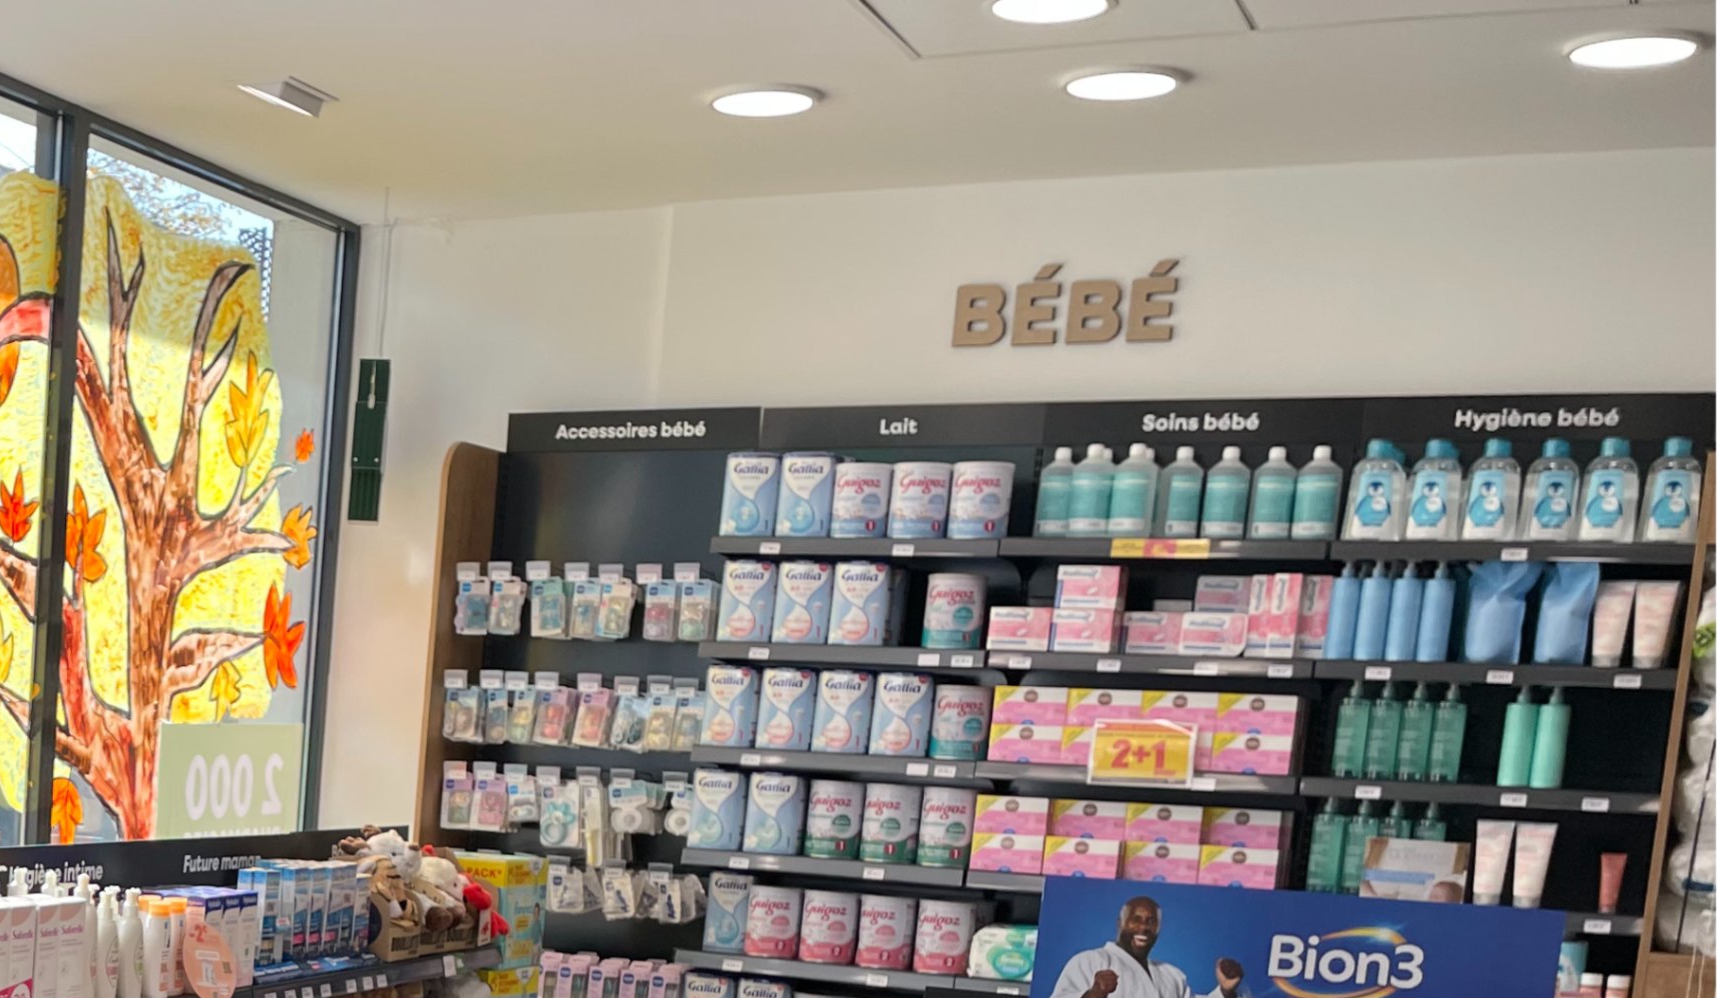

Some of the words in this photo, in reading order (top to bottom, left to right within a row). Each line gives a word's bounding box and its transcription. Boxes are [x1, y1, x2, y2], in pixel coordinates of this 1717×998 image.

[951, 258, 1181, 348] BÉBÉ
[555, 422, 657, 441] Accessoires
[660, 419, 706, 439] bébé
[879, 418, 918, 436] Lait
[1141, 413, 1200, 433] Soins
[1203, 411, 1261, 433] bébé
[1454, 408, 1553, 433] Hygiène
[1558, 407, 1620, 428] bébé
[1111, 738, 1171, 775] 2+1
[64, 860, 103, 883] intime
[183, 855, 219, 873] Future
[1267, 933, 1424, 990] Bion3
